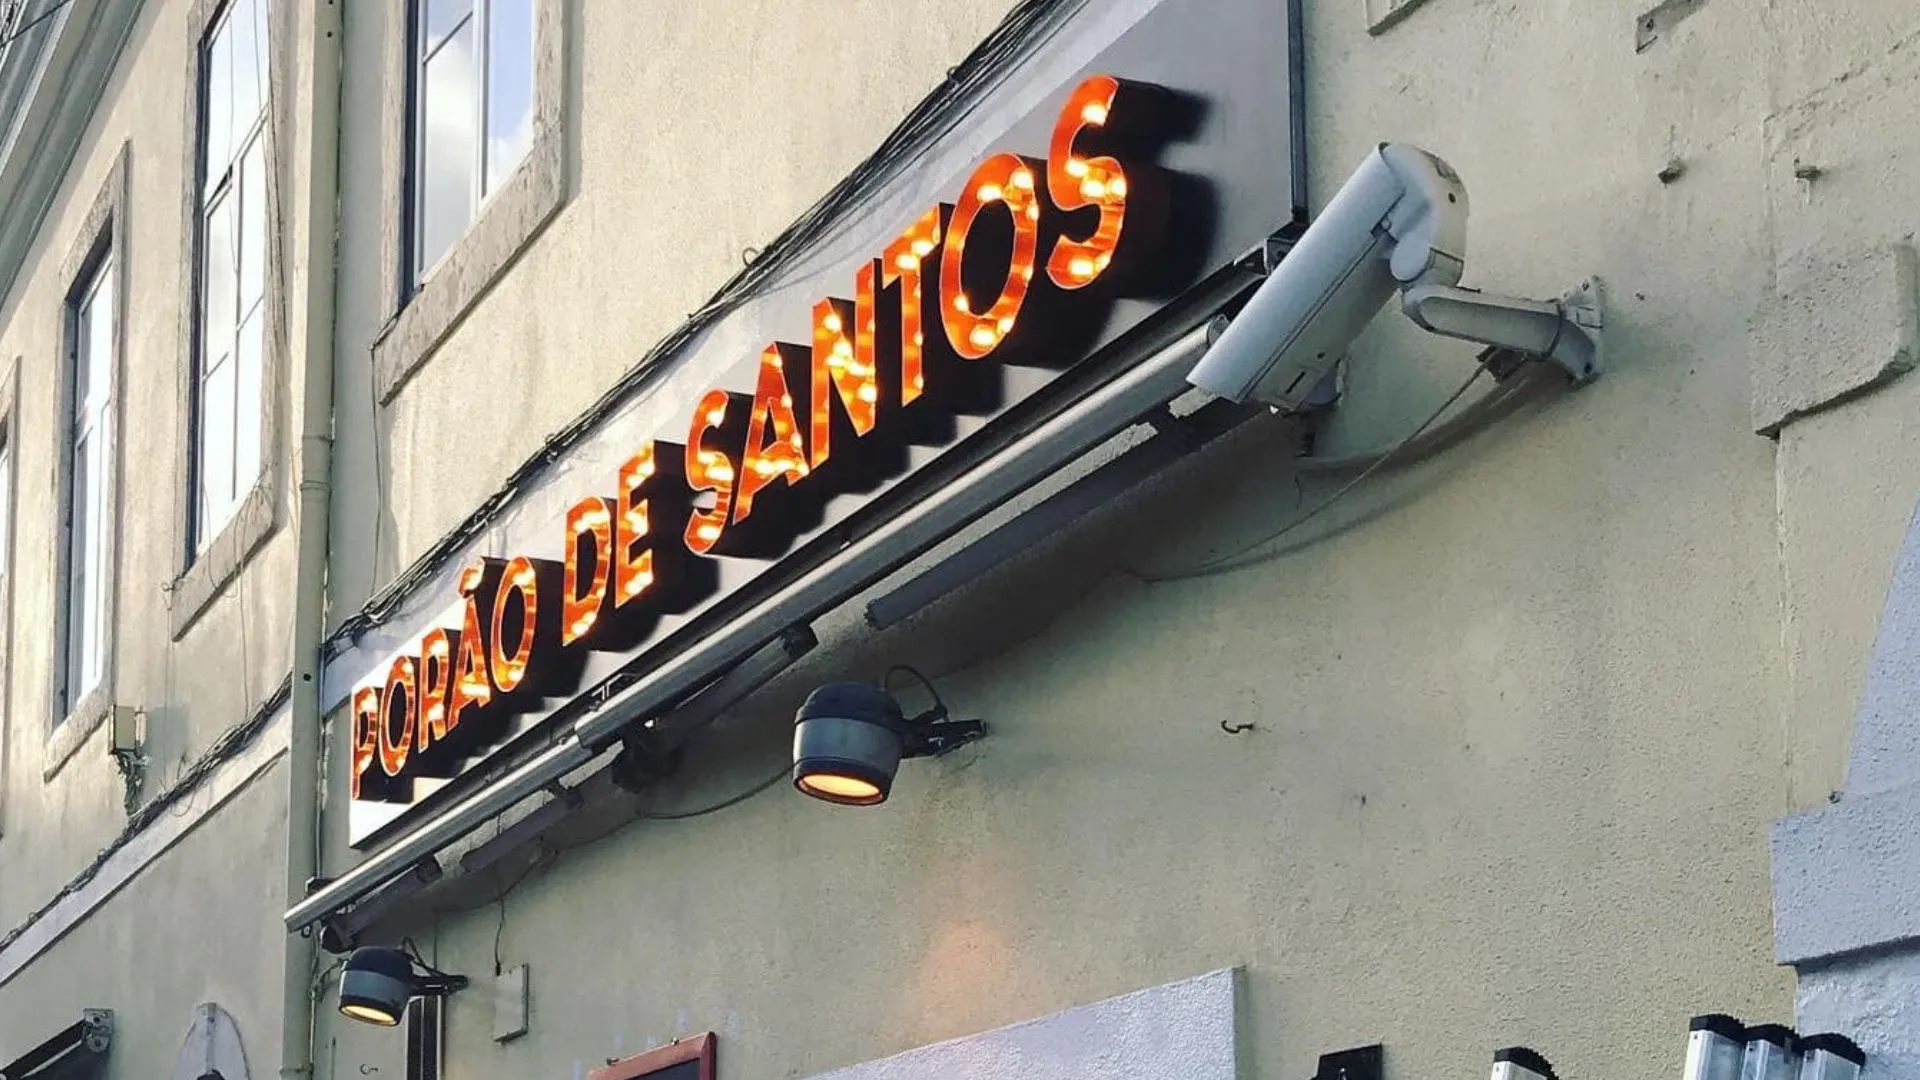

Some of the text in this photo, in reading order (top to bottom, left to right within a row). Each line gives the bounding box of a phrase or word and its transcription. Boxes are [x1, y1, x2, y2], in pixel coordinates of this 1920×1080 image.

[351, 74, 1127, 800] PORÃO DE SANTOS
